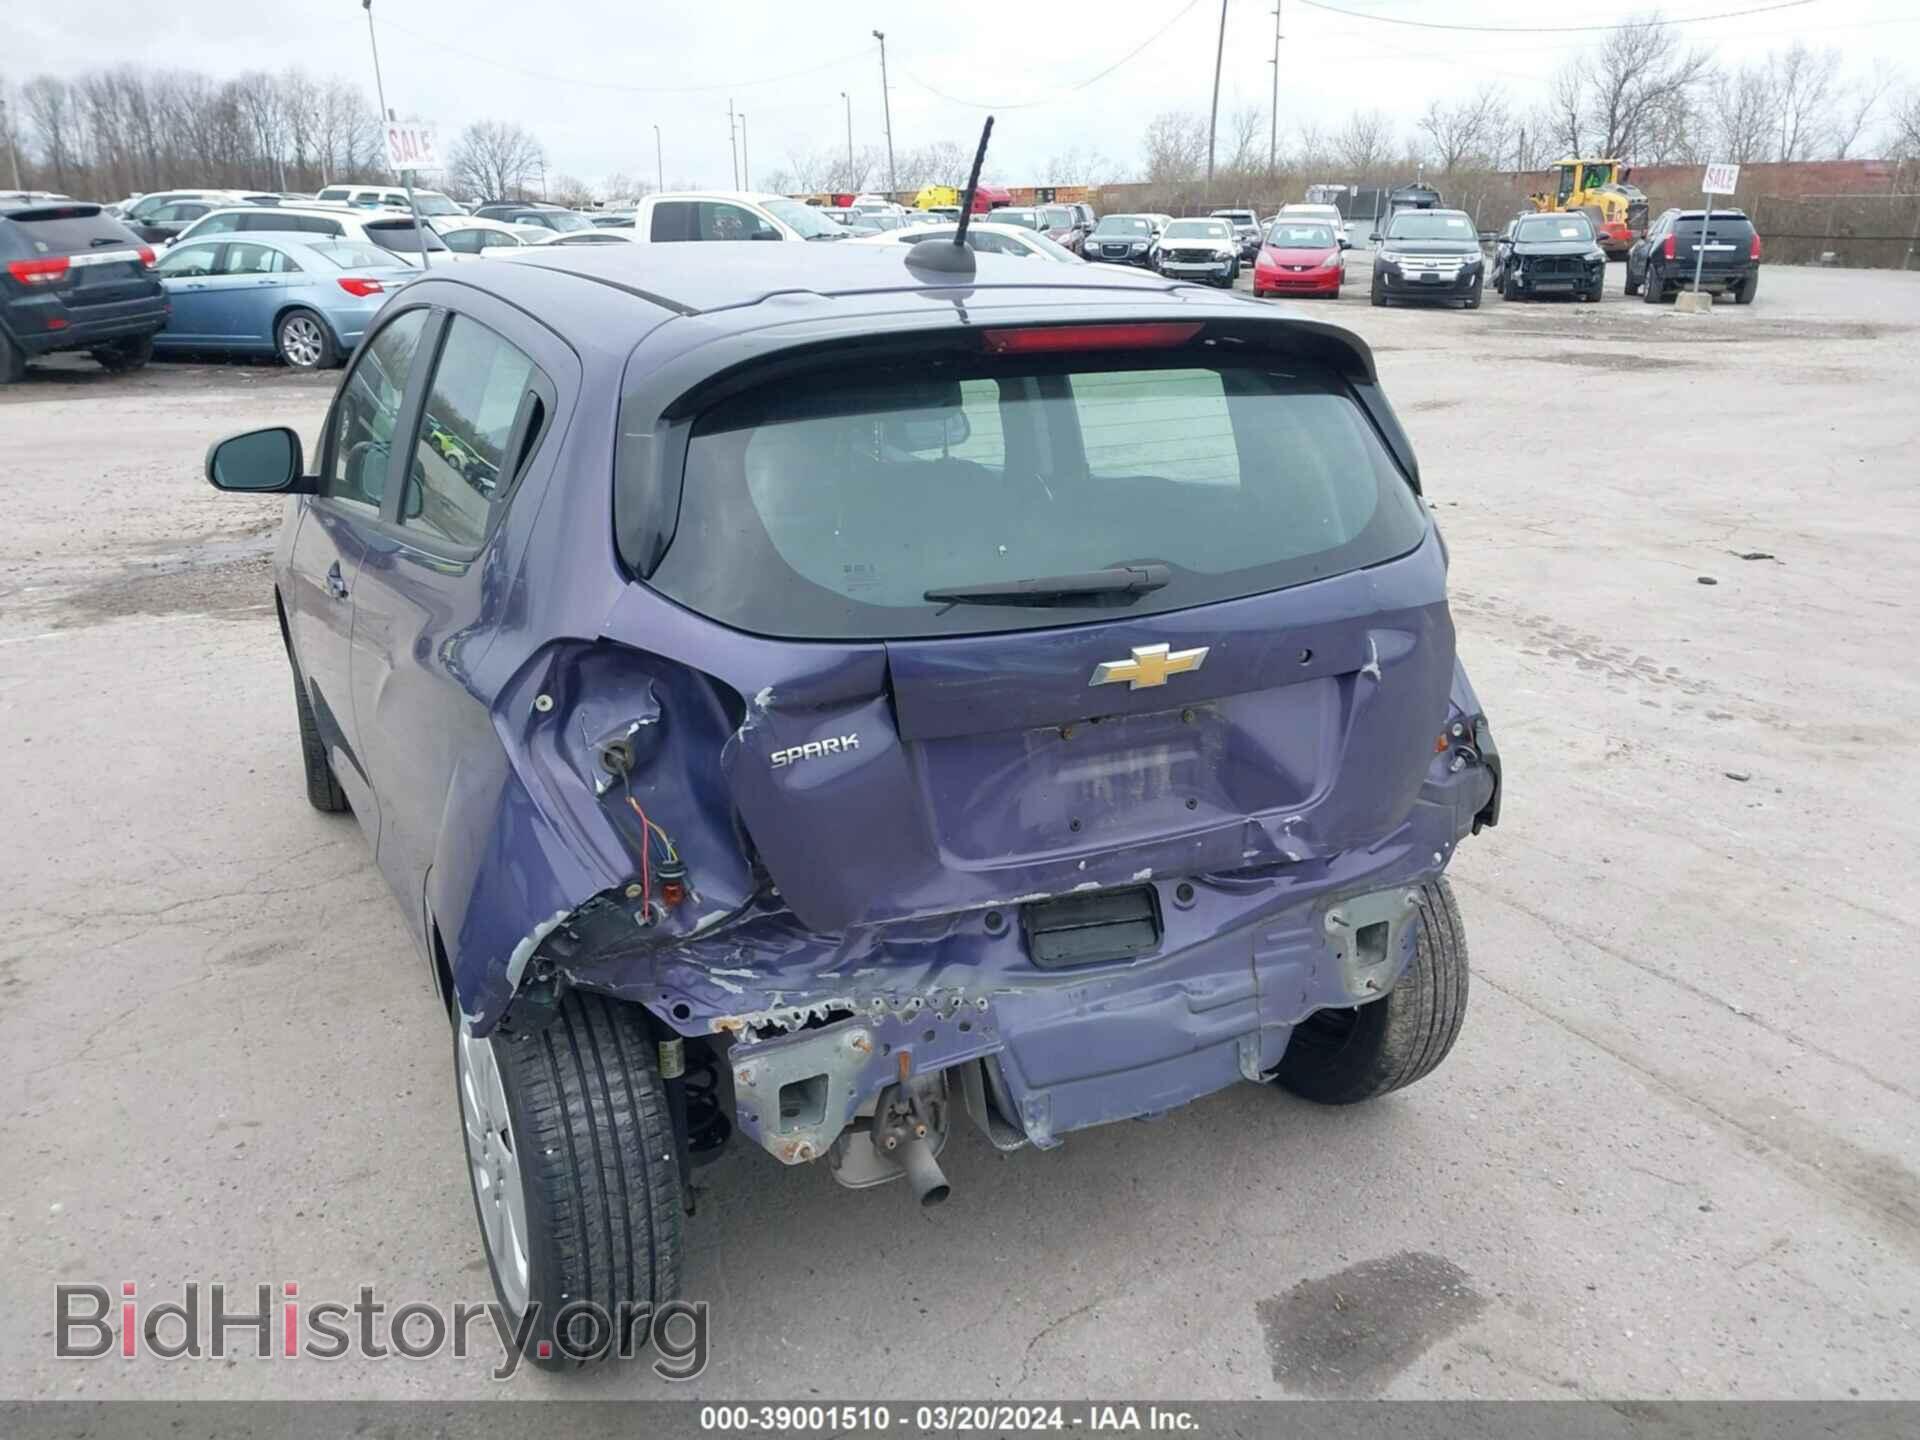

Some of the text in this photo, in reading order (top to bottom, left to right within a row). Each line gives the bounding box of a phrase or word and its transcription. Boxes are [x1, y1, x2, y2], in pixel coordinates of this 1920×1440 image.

[388, 128, 433, 162] SALE
[1705, 167, 1735, 189] SALE
[770, 732, 860, 769] SPARK
